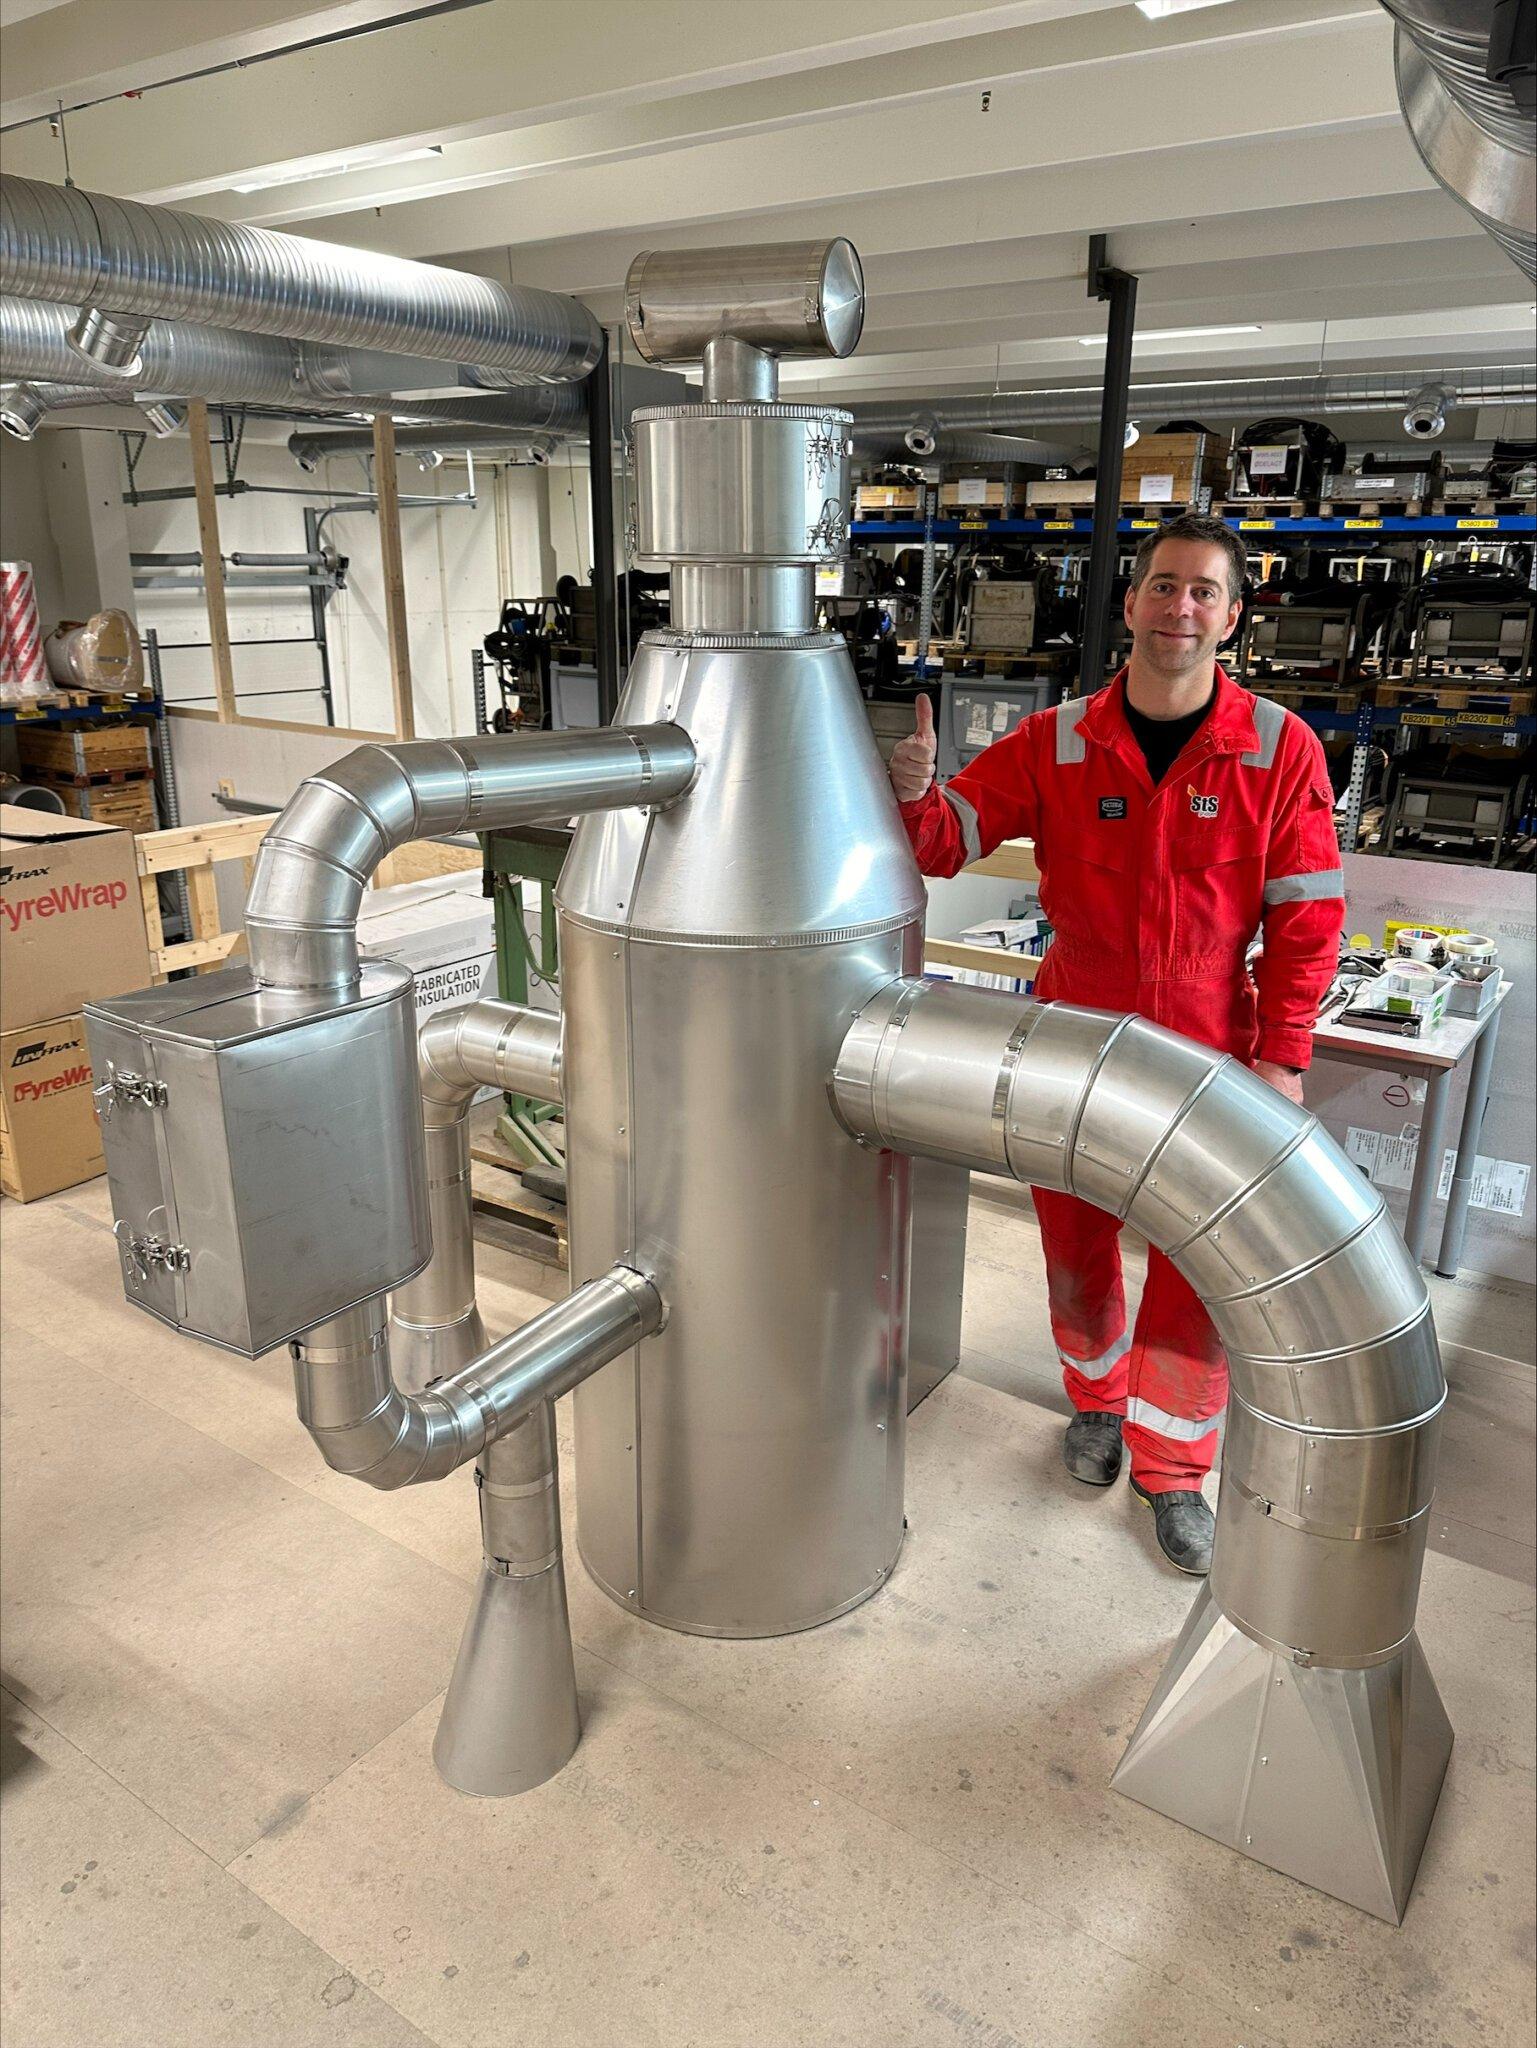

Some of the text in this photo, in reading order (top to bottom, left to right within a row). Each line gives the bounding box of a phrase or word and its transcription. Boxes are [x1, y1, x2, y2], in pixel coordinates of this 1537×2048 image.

[1403, 714, 1430, 723] KB2301
[1459, 713, 1489, 723] KB2302
[415, 965, 481, 993] FABRICATED
[415, 979, 480, 1008] INSULATION
[14, 1065, 93, 1102] FyreWr
